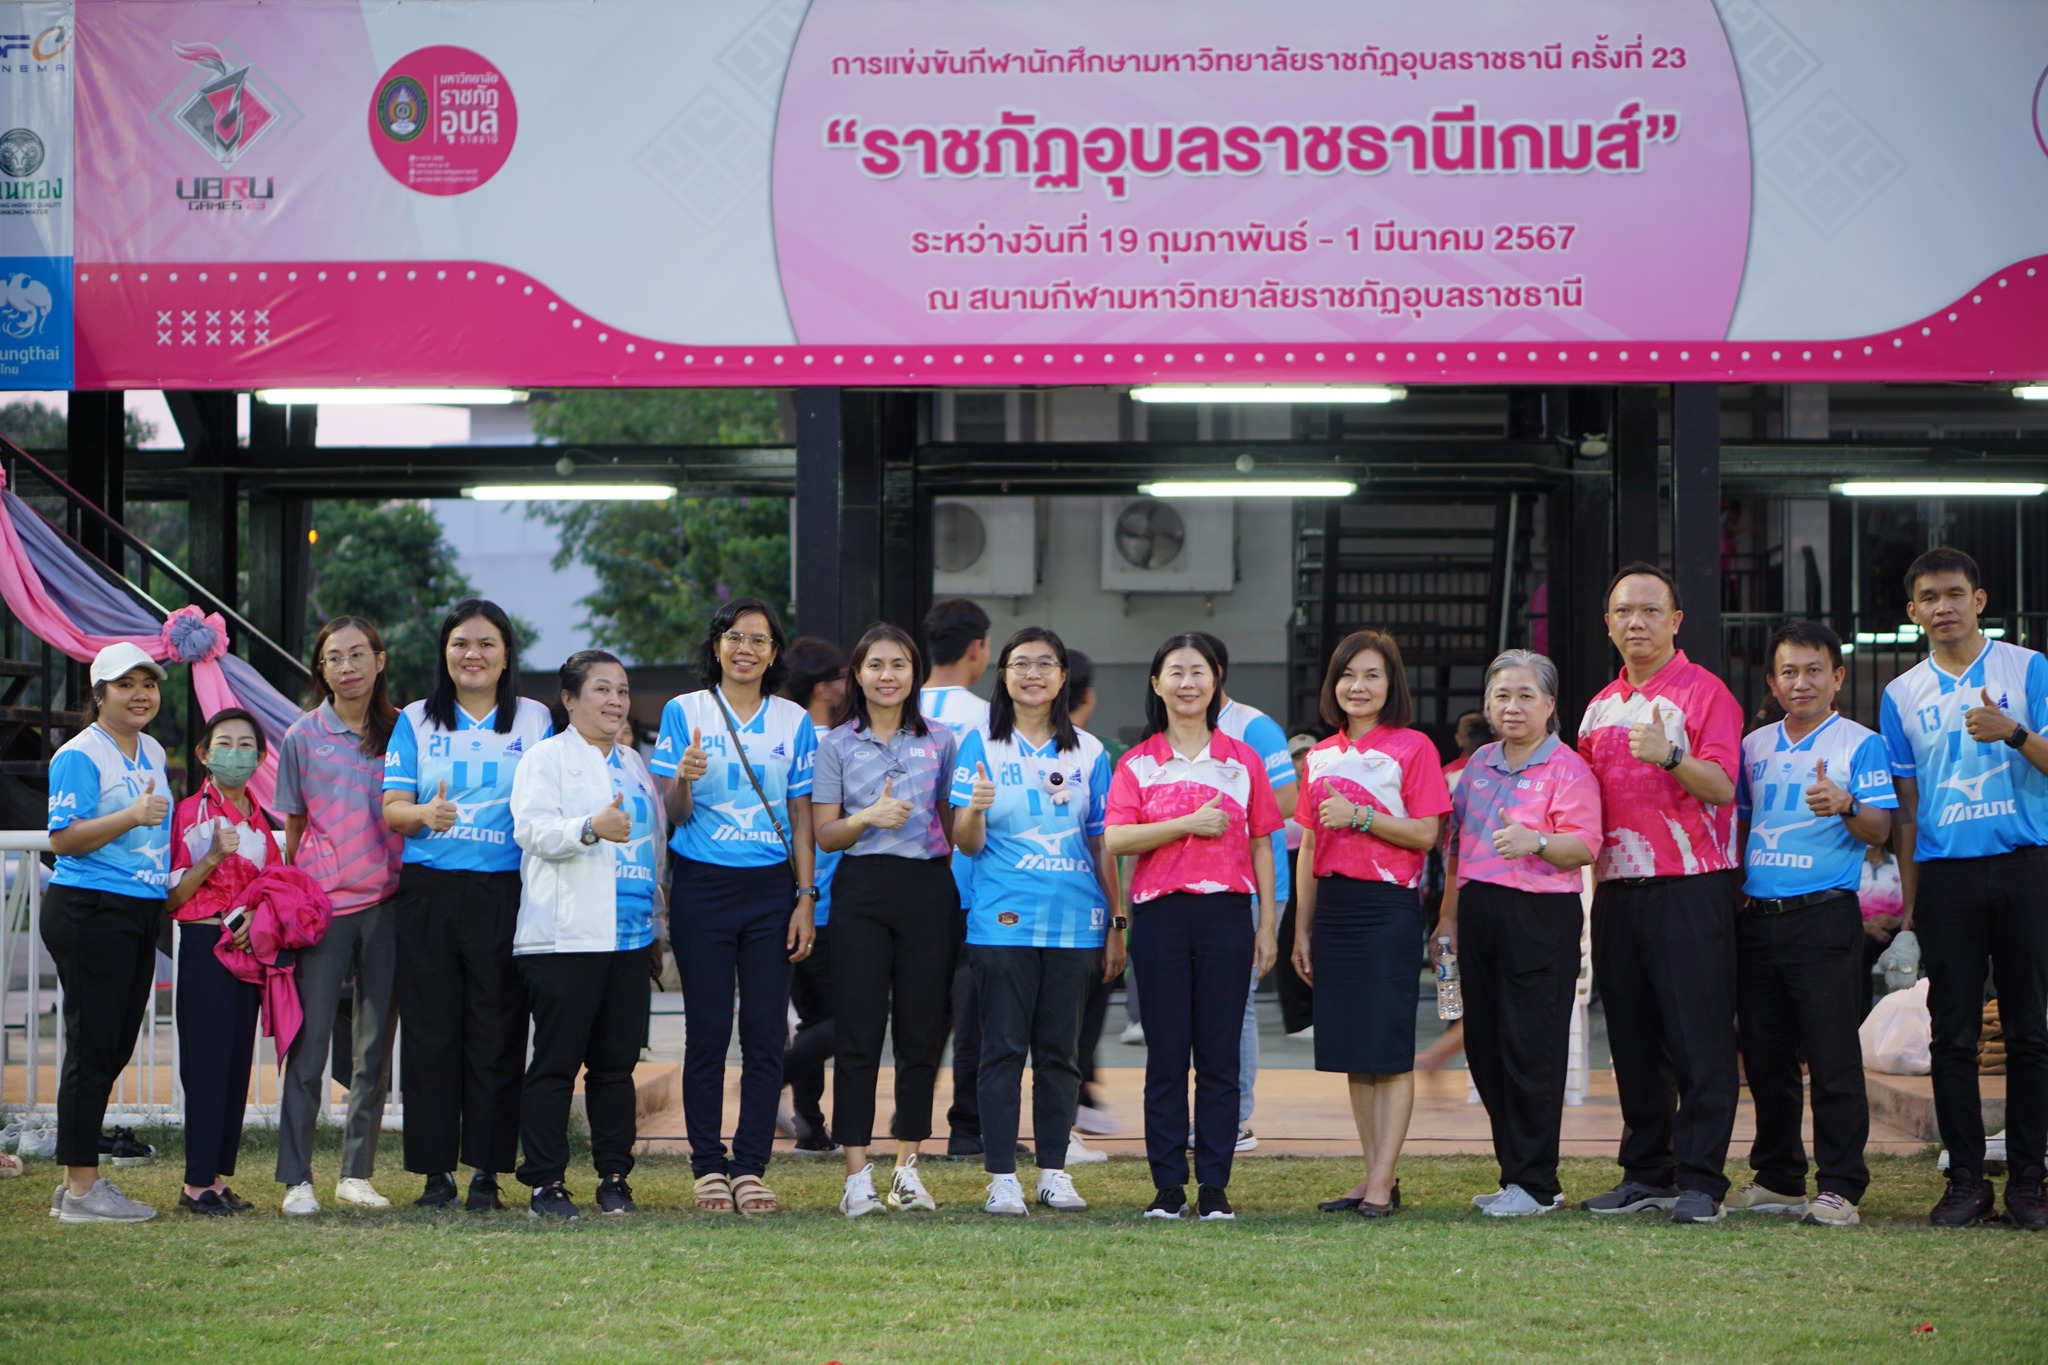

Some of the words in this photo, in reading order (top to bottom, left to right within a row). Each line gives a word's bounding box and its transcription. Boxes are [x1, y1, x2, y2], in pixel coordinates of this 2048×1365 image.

[831, 42, 1562, 80] การแข่งขันกีฬานักศึกษามหาวิทยาลัยราชภัฏอุบลราชธานี
[1570, 34, 1643, 69] ครั้งที่
[1650, 47, 1688, 69] 23
[440, 109, 499, 145] อุบล
[175, 175, 274, 200] UBRU
[188, 200, 242, 211] GAMES
[911, 212, 1087, 254] ระหว่างวันที่
[1100, 228, 1138, 253] 19
[1148, 220, 1308, 264] กุมภาพันธ์
[1346, 227, 1359, 251] 1
[1374, 220, 1484, 251] มีนาคม
[1494, 225, 1576, 251] 2567
[928, 289, 958, 310] ณ
[969, 276, 1582, 319] สนามกีฬามหาวิทยาลัยราชภัฏอุบลราชธานี
[1917, 704, 1942, 734] 13
[429, 733, 451, 757] 21
[701, 735, 727, 757] 24
[1858, 768, 1894, 790] UB
[1749, 848, 1814, 870] MIZUNO
